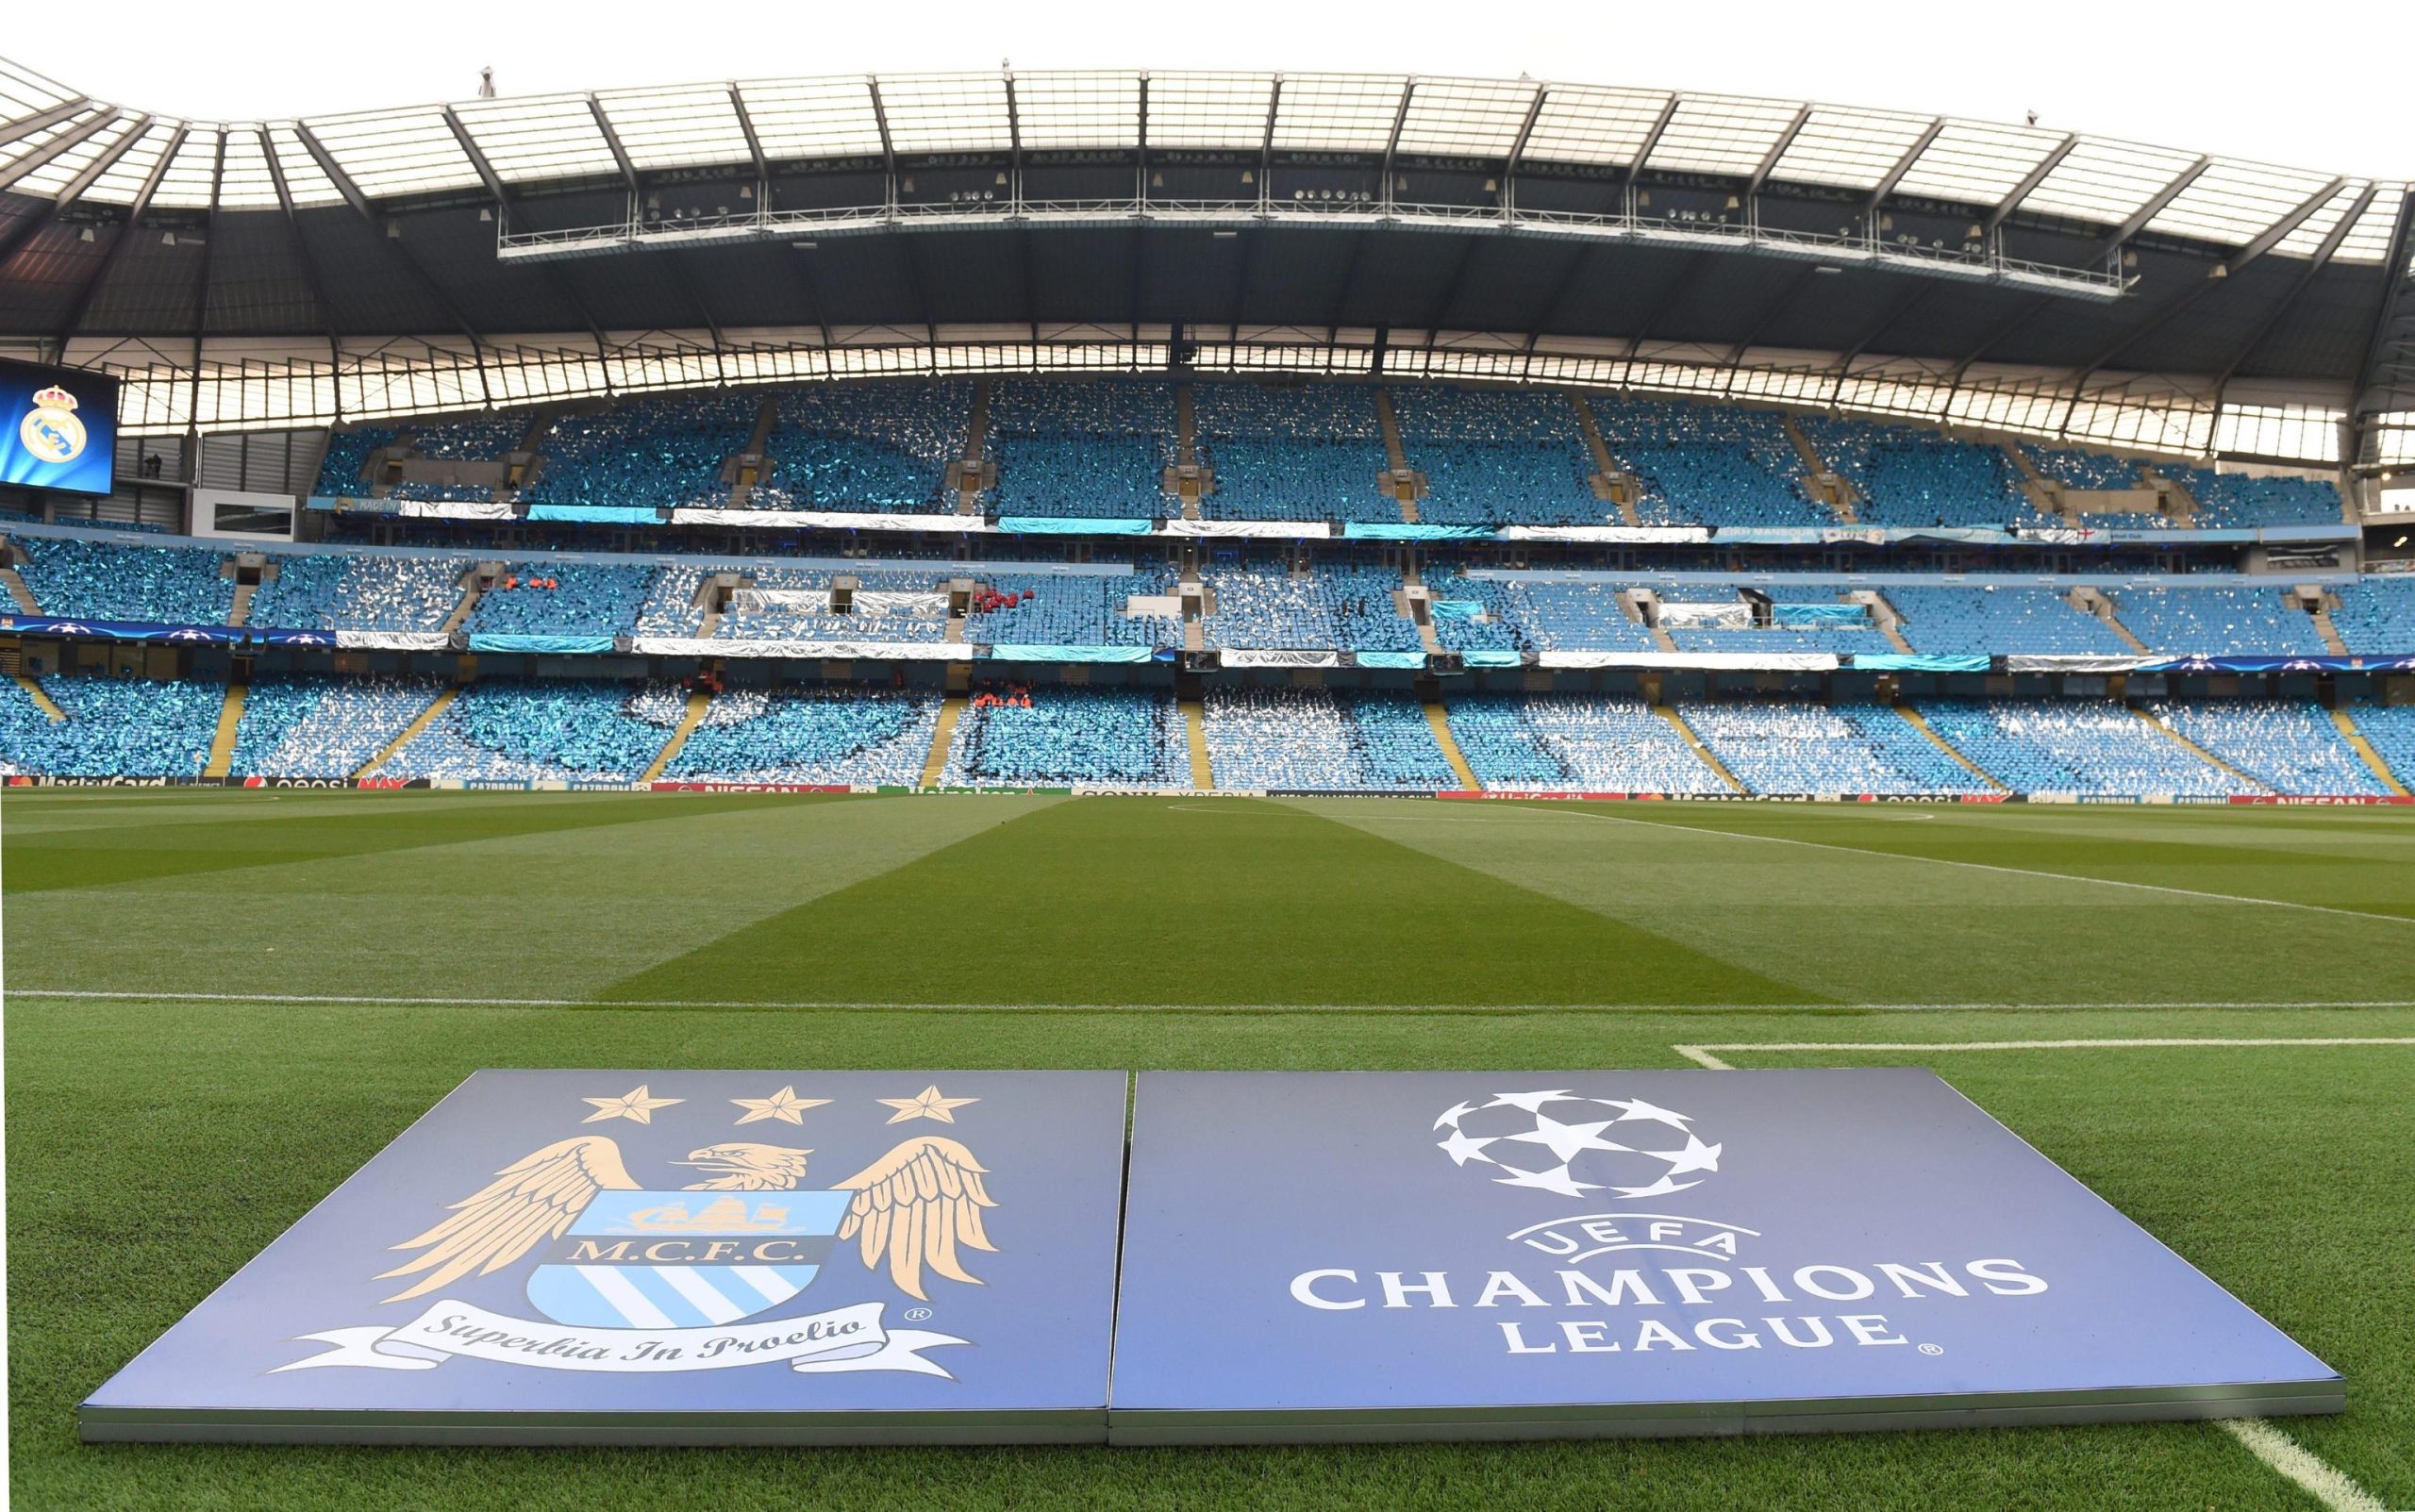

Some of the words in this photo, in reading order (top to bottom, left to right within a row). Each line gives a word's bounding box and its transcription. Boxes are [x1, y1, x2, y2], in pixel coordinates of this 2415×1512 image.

[566, 1240, 805, 1261] M.C.F.C.
[1523, 1220, 1741, 1256] UEFA
[1289, 1258, 2050, 1311] CHAMPIONS
[422, 1313, 611, 1362] Superbia
[620, 1340, 682, 1362] In
[698, 1318, 867, 1361] Proelio
[1496, 1314, 1910, 1354] LEAGUE
